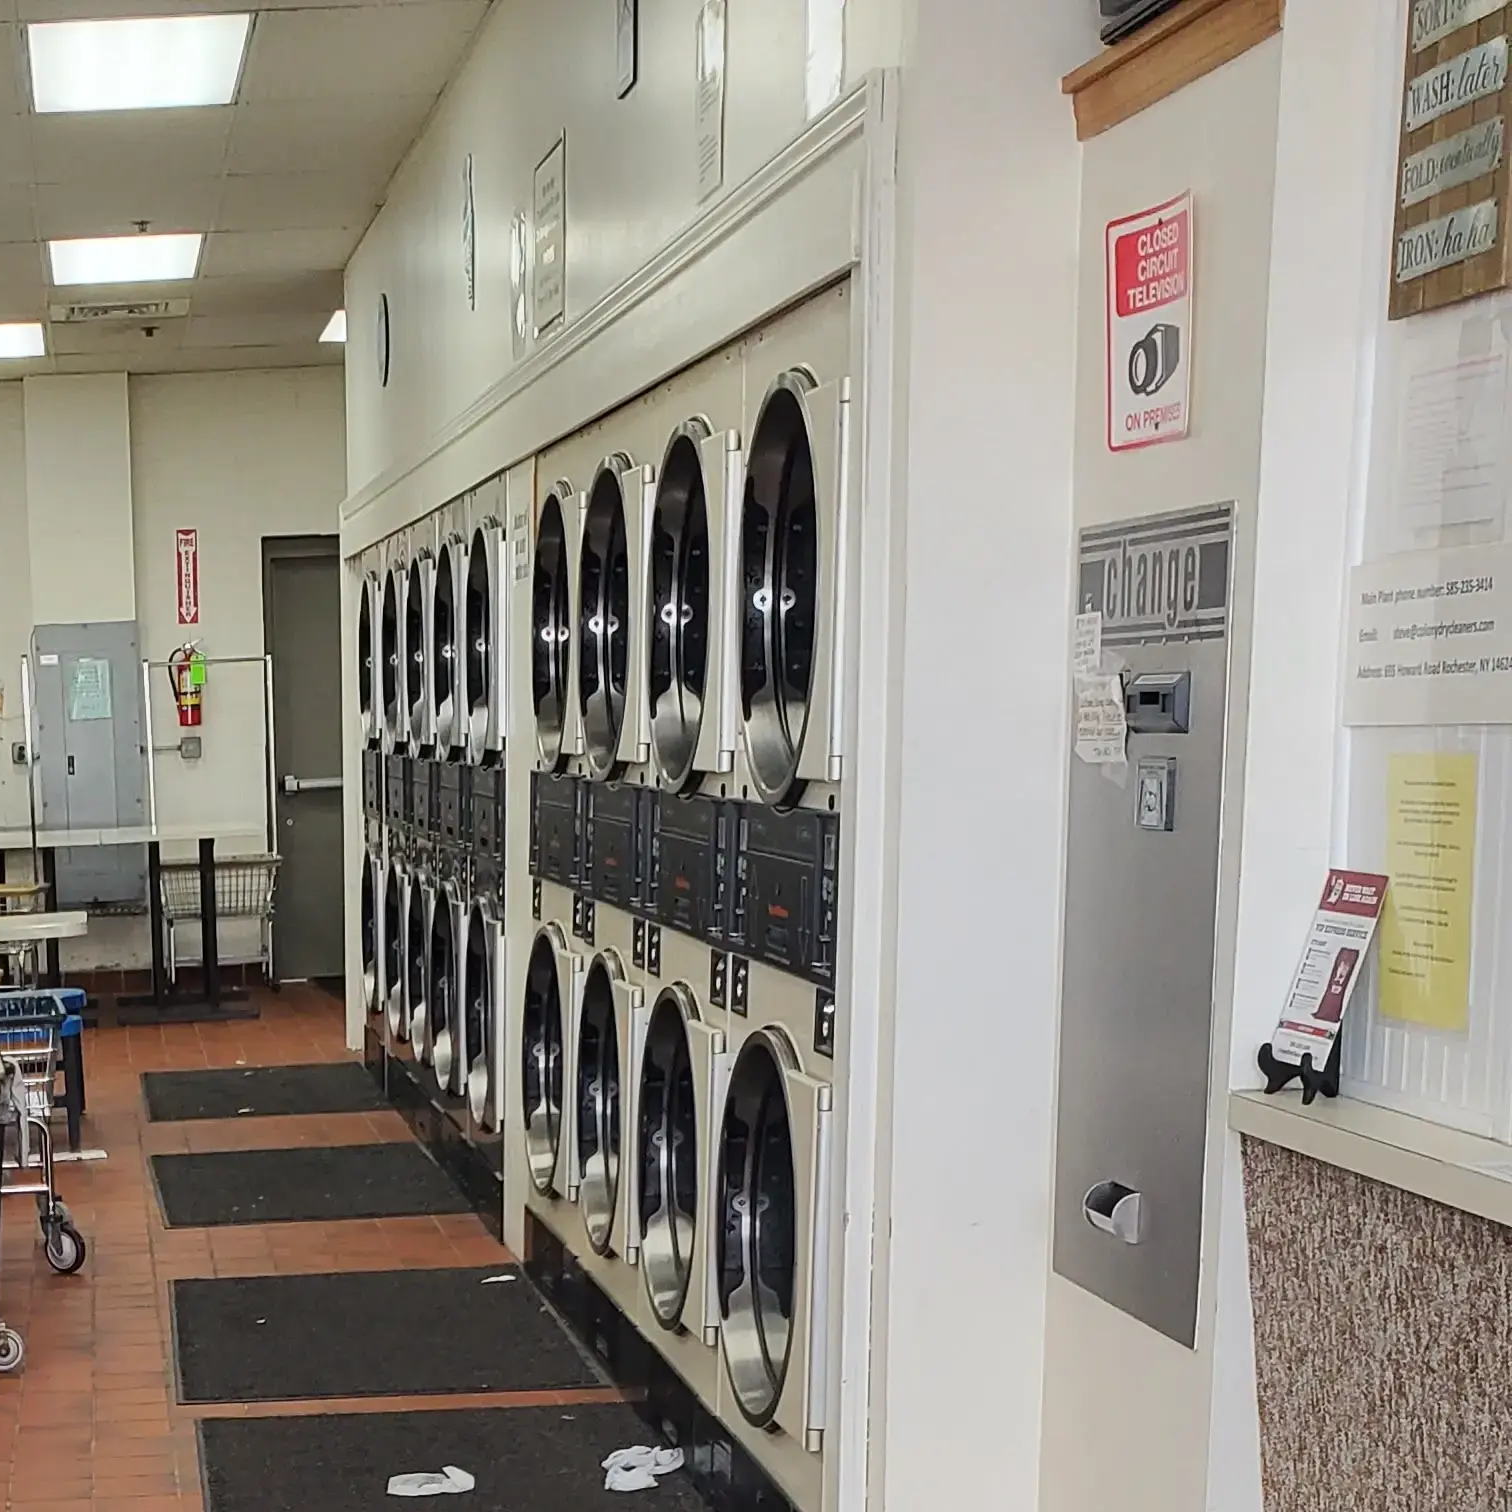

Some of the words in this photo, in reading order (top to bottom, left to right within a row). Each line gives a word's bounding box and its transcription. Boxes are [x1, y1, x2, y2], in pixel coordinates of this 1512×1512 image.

[1412, 69, 1455, 118] WASH:
[1457, 51, 1500, 101] later
[1403, 156, 1438, 195] FOLD:
[1137, 222, 1179, 257] CLOSED
[1400, 229, 1439, 273] IRON:
[1441, 216, 1464, 258] ha
[1466, 206, 1490, 250] ha
[1137, 247, 1179, 281] CIRCUIT
[1126, 269, 1186, 310] TELEVISION
[1125, 411, 1141, 432] ON
[1103, 536, 1200, 630] change
